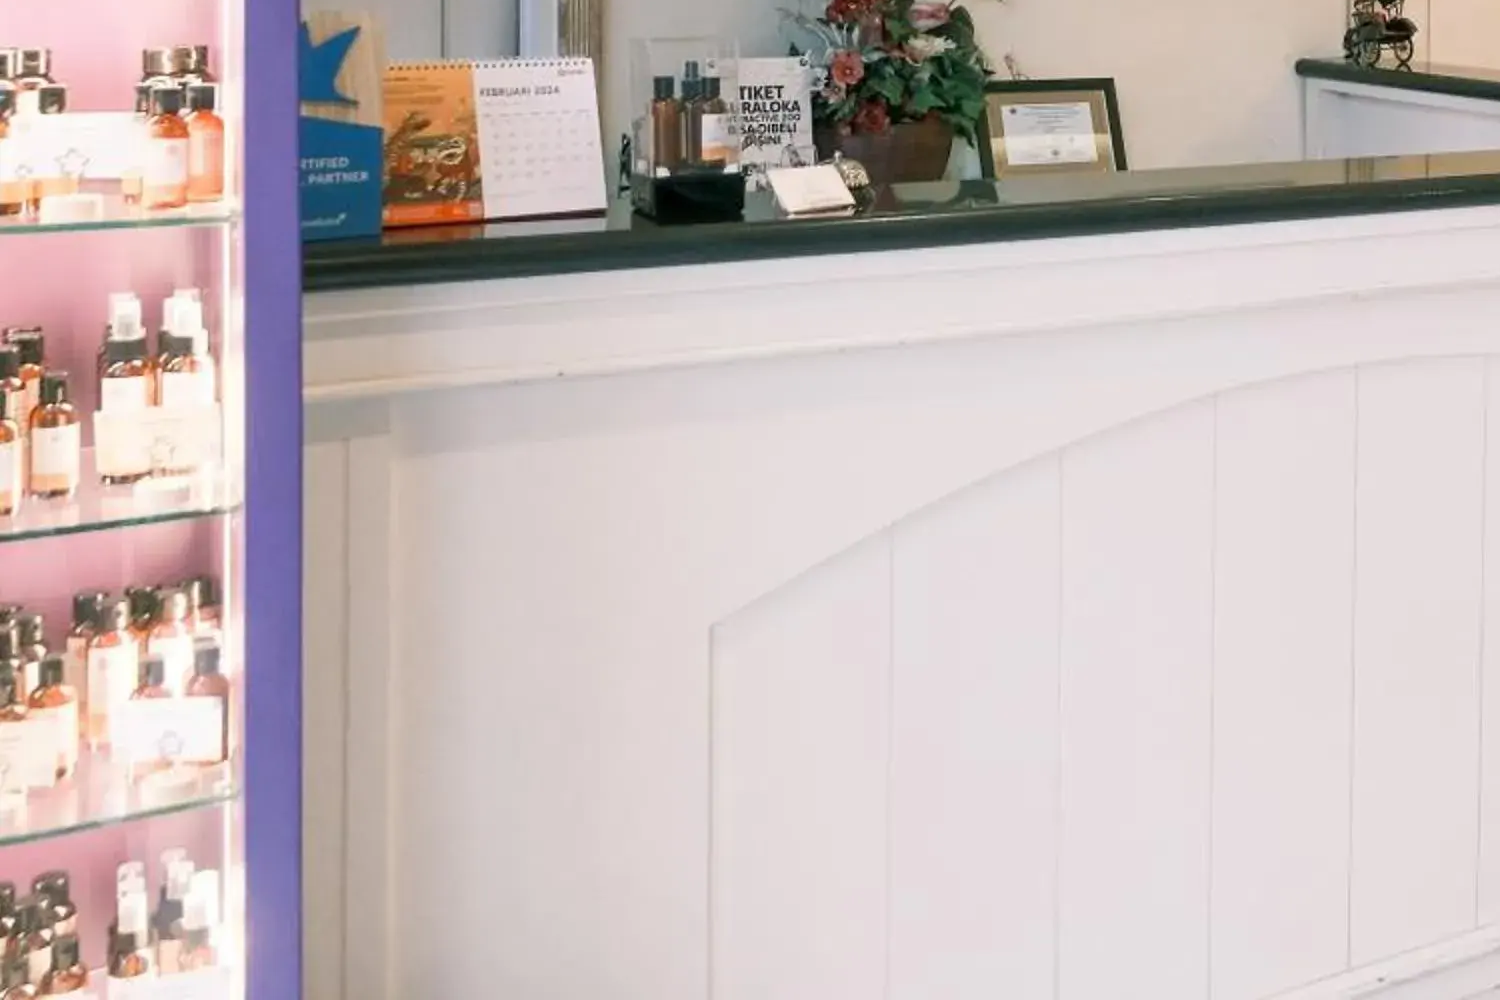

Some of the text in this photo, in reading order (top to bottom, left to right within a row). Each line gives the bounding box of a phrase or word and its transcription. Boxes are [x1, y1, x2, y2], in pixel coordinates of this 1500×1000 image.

[480, 87, 531, 96] FEBRUARI
[740, 85, 784, 100] TIKET
[727, 100, 801, 113] RALOKA
[300, 156, 349, 169] RTIFIED
[308, 171, 368, 184] PARTNER
